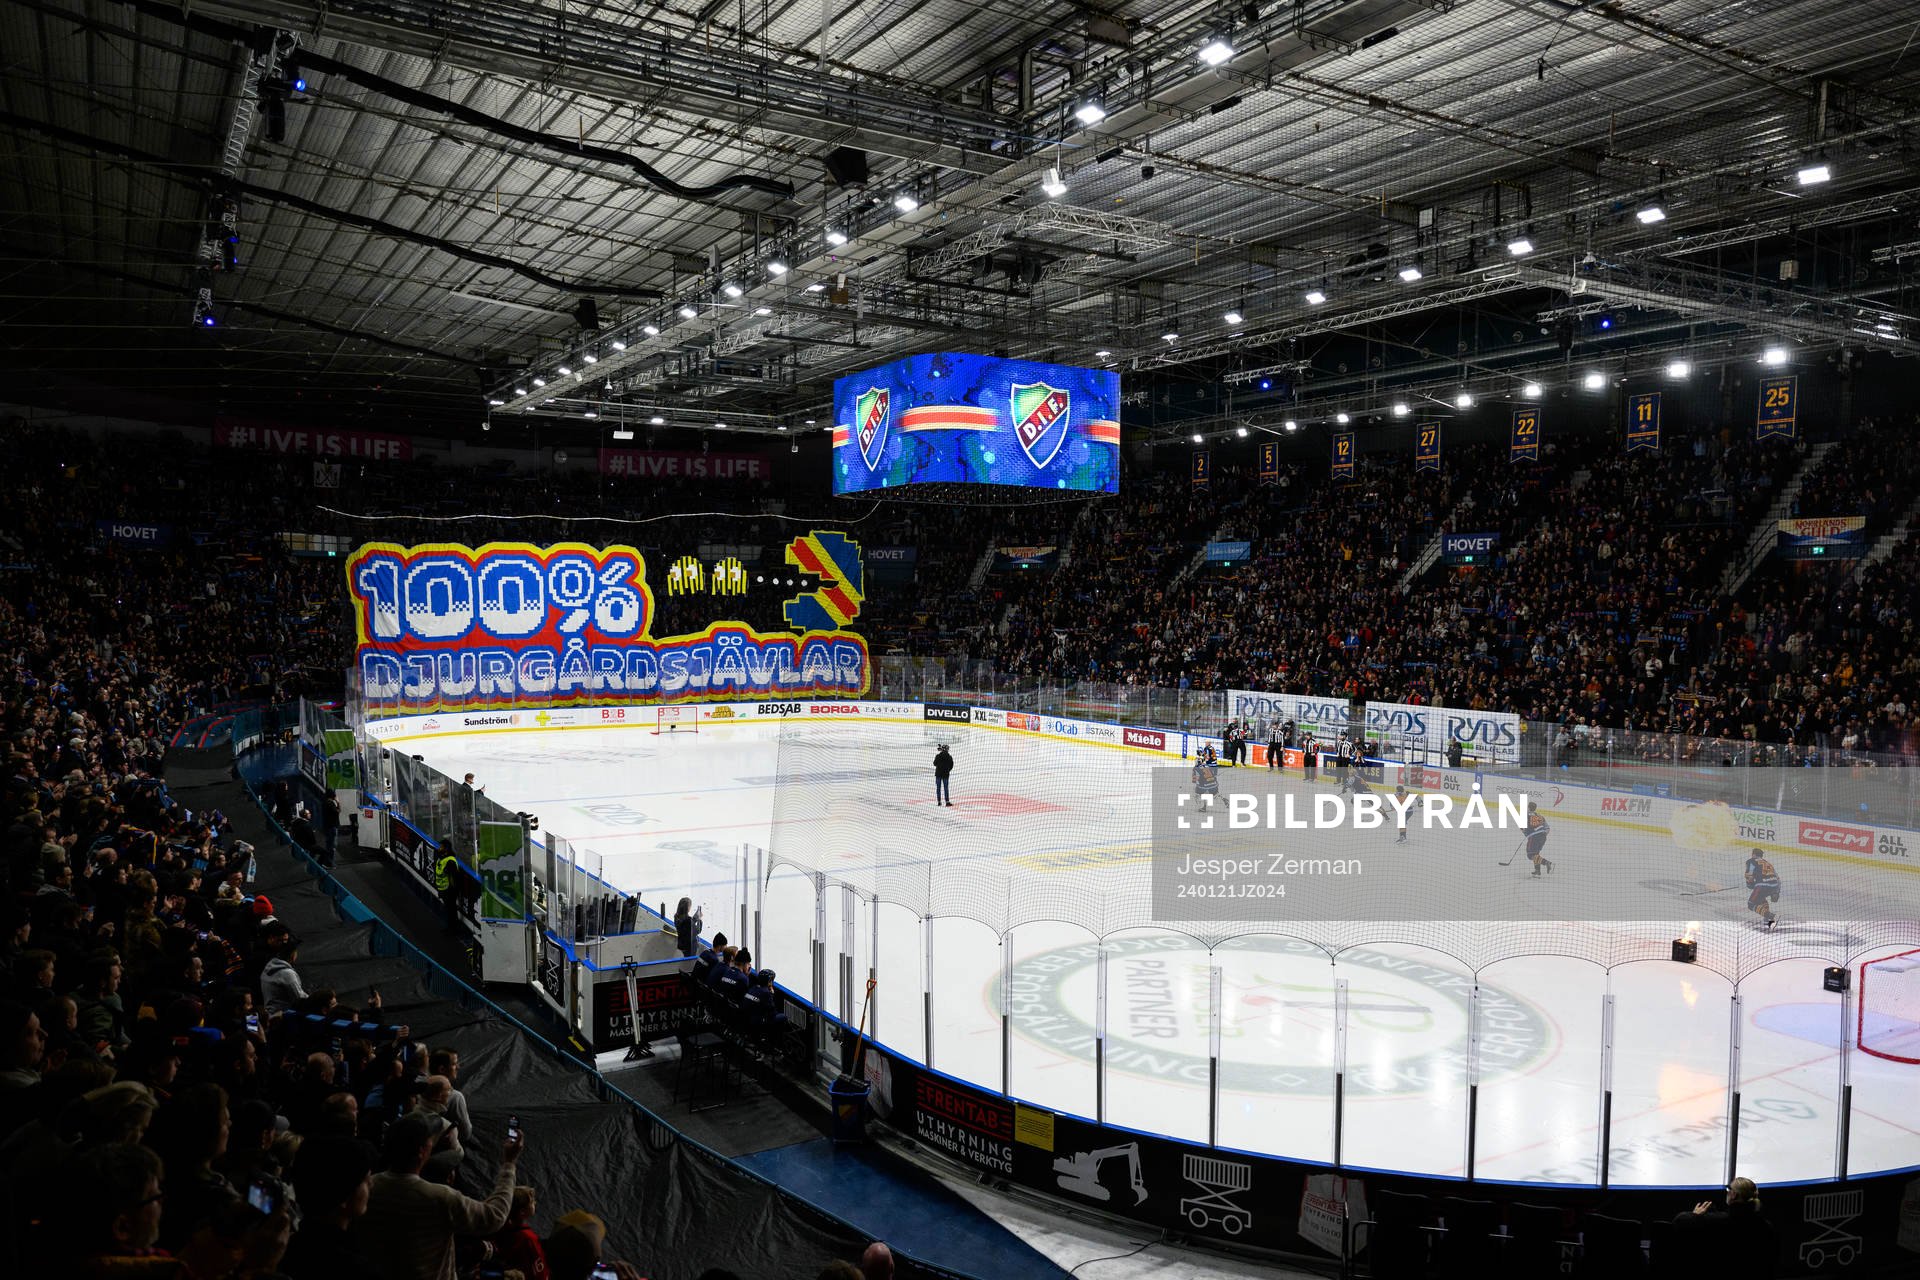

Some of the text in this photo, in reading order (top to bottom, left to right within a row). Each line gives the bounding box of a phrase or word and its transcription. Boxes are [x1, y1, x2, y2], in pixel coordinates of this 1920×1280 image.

[1765, 387, 1790, 407] 25
[1023, 397, 1064, 440] D.I.F.
[1637, 402, 1652, 421] 11
[1517, 418, 1535, 435] 22
[316, 433, 342, 456] IS
[1420, 430, 1436, 446] 27
[1336, 441, 1350, 456] 12
[1197, 458, 1204, 471] 2
[1265, 450, 1272, 464] 5
[609, 455, 760, 479] #LIVE IS LIFE
[112, 525, 157, 540] HOVET
[1447, 538, 1493, 552] HOVET
[867, 549, 905, 560] HOVET
[359, 557, 641, 640] 100%
[758, 703, 802, 717] BEDSAB
[810, 705, 860, 714] BORGA
[927, 708, 969, 719] DIVELLO
[1235, 695, 1285, 720] RYDS
[1297, 701, 1350, 726] RYDS
[464, 716, 508, 726] Sundström
[974, 710, 987, 722] XXL
[1366, 707, 1427, 735] RYDS
[1055, 720, 1078, 735] Ocab
[1090, 727, 1115, 738] STARK
[1447, 715, 1516, 747] RYDS
[1127, 732, 1162, 746] Miele
[1444, 774, 1458, 783] ALL
[1801, 828, 1870, 848] CCM
[1878, 834, 1904, 847] ALL
[1878, 845, 1909, 858] OUT.
[1123, 958, 1180, 1038] PARTNER
[925, 1087, 999, 1129] FRENTAB
[916, 1110, 1012, 1162] UTHYRNING
[917, 1126, 1012, 1174] MASKINER & VERKTYG
